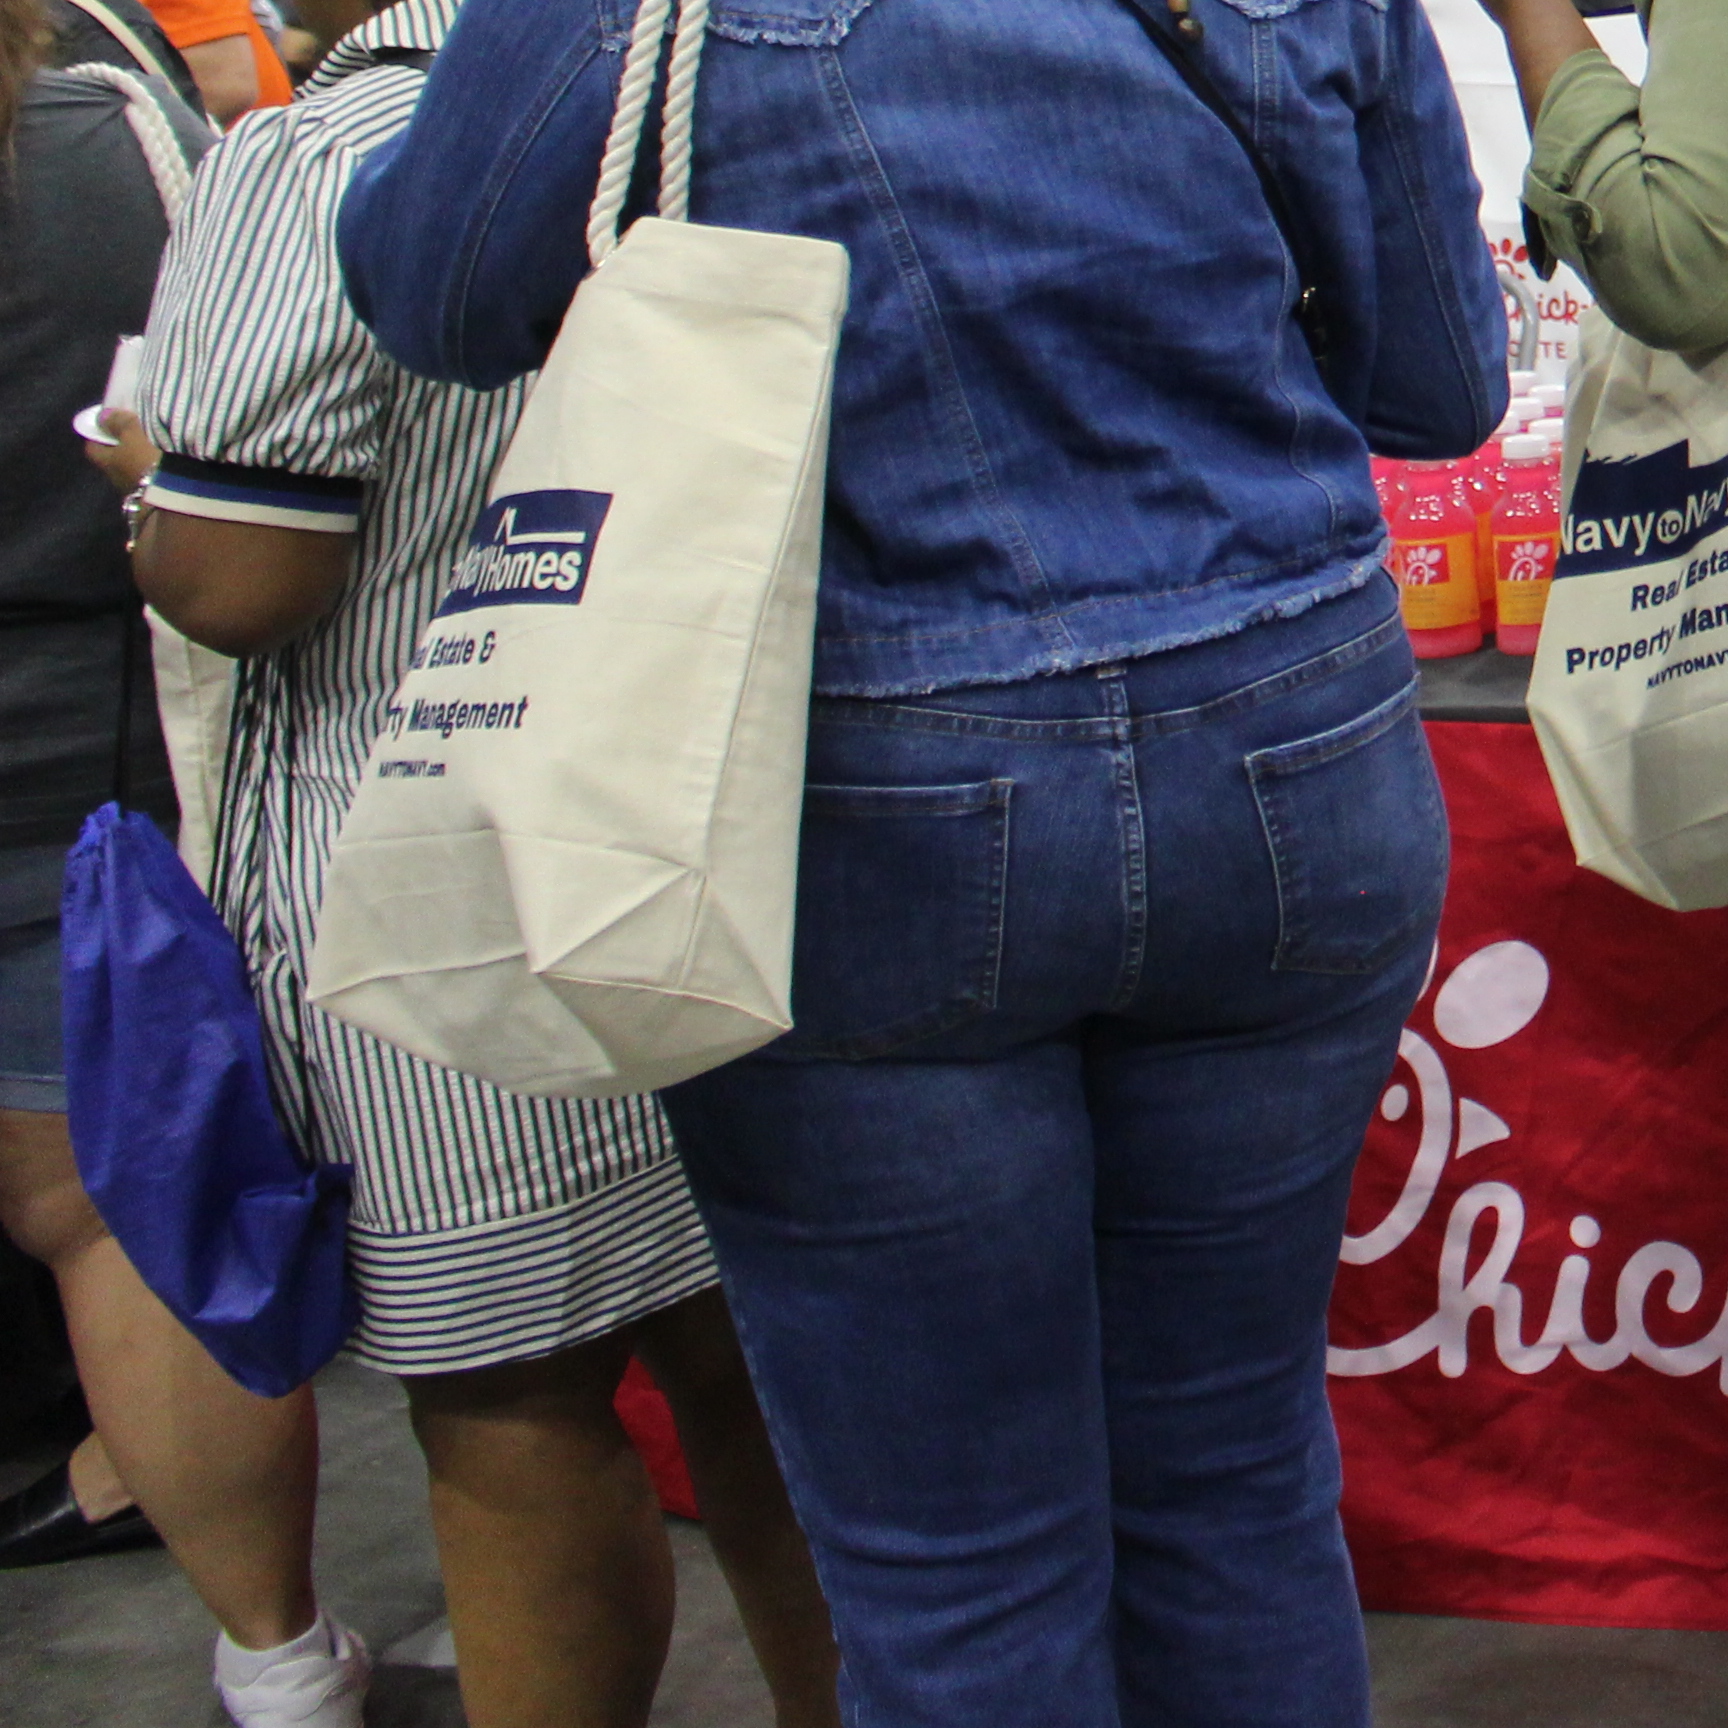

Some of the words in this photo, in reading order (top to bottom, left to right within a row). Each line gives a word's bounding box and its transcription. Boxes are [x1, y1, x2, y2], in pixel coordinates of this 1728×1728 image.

[1631, 570, 1685, 612] Real
[479, 630, 497, 665] &
[1566, 624, 1676, 674] Property
[407, 694, 529, 740] Management
